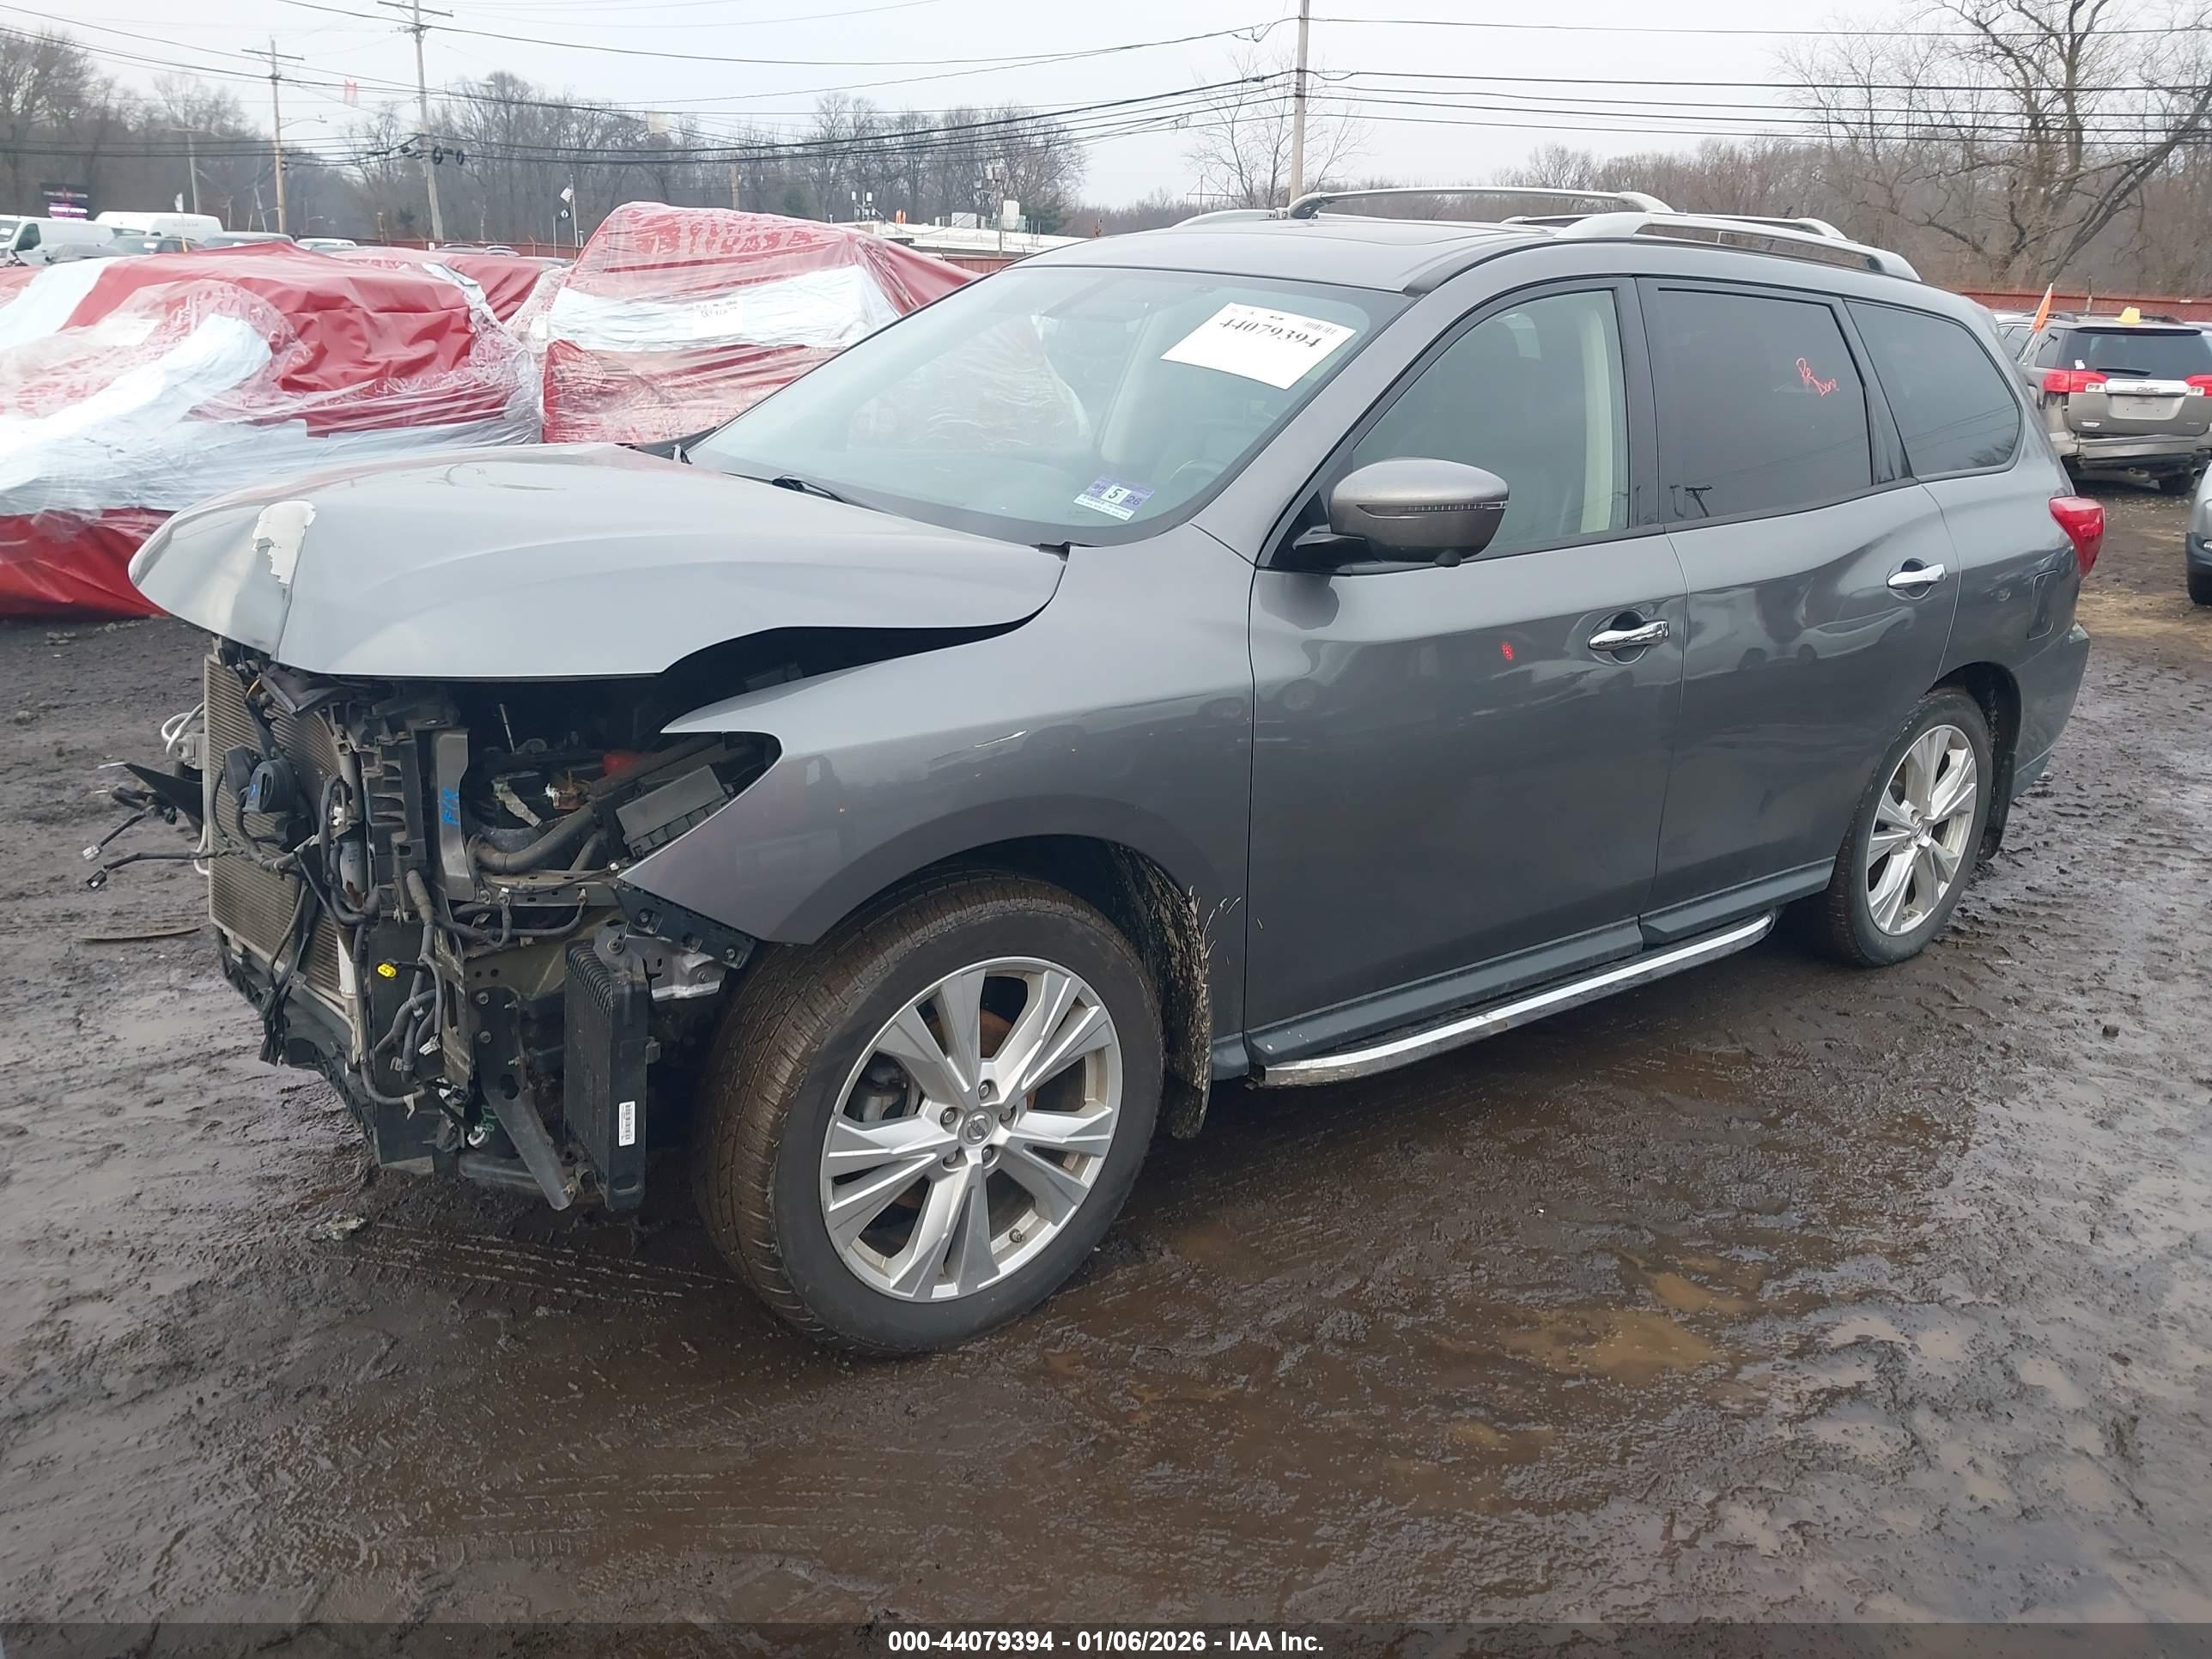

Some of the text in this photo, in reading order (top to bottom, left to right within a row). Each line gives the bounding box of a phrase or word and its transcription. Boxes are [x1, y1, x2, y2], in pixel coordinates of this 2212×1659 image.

[1218, 318, 1323, 348] 44079394
[1108, 488, 1123, 500] 5
[1125, 495, 1142, 507] 26
